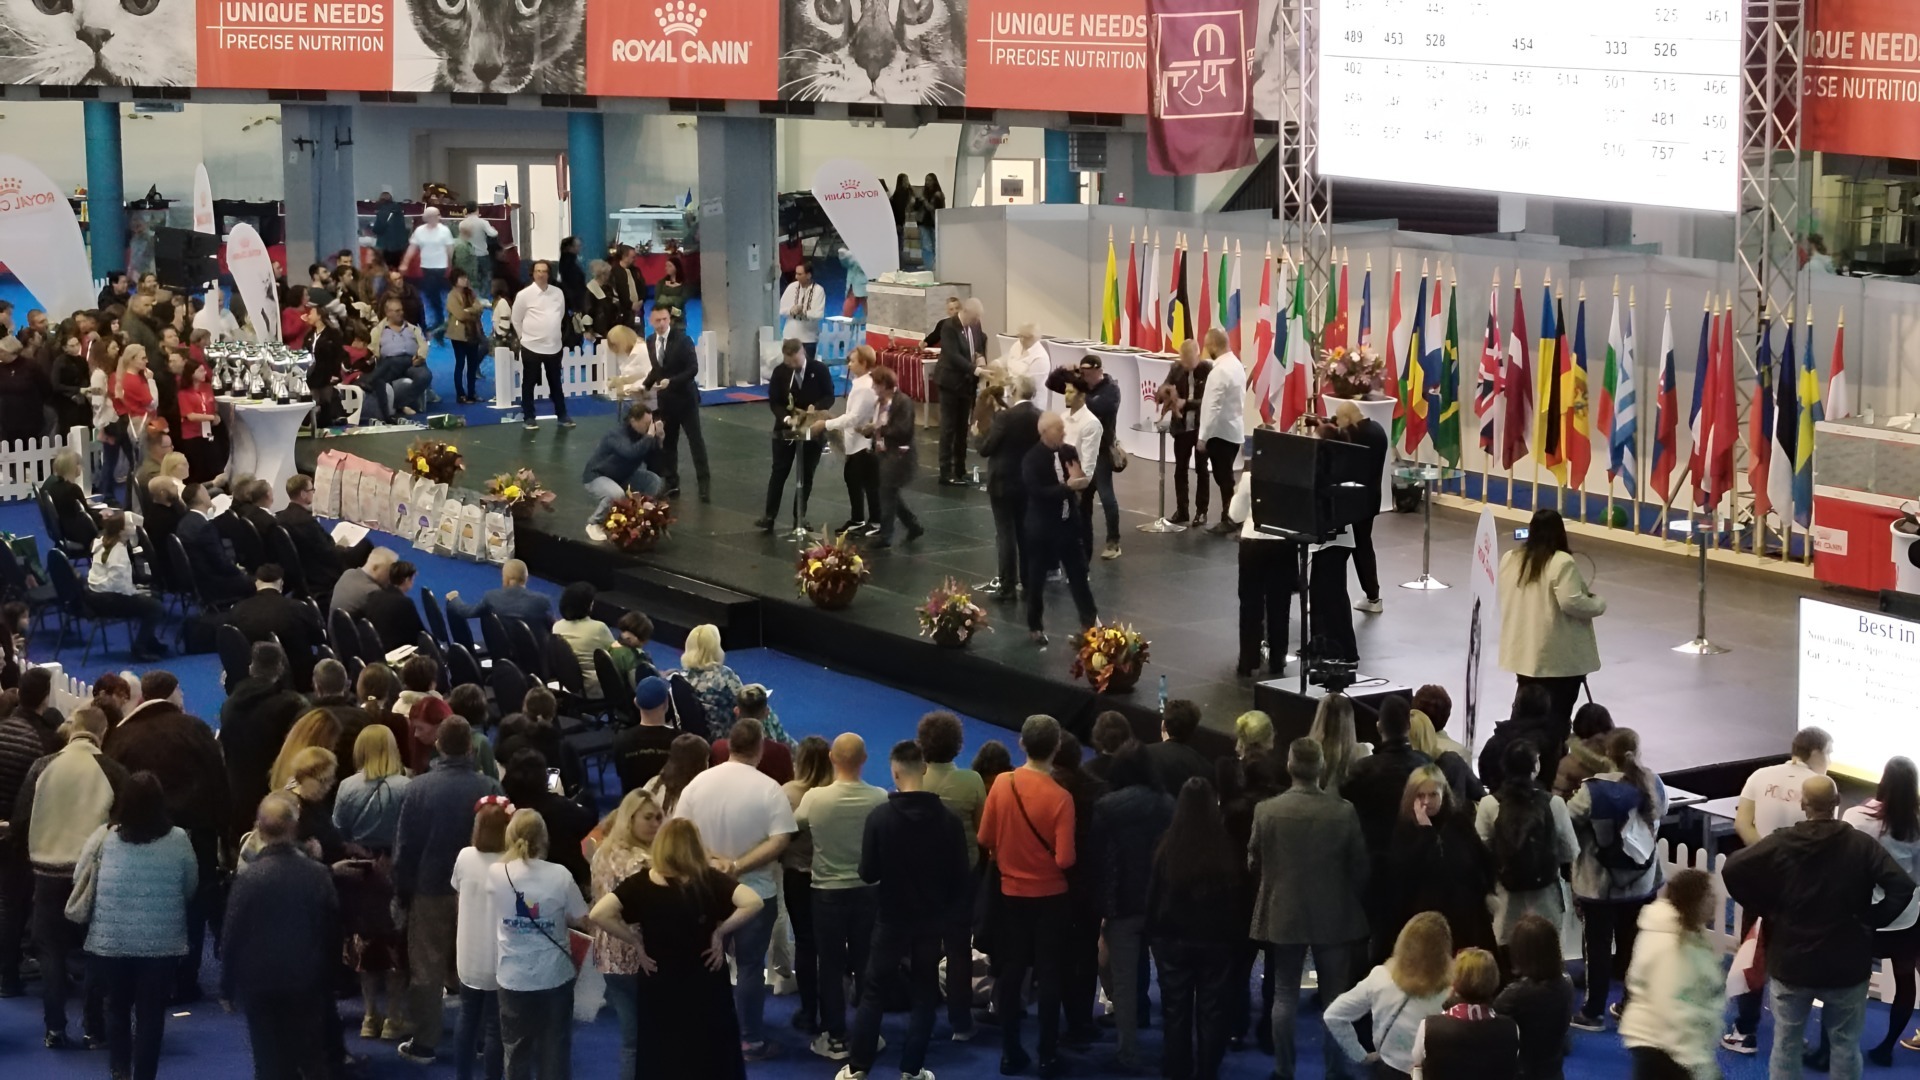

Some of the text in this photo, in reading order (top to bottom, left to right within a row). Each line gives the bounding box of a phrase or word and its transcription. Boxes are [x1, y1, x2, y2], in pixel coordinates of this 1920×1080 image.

[226, 2, 384, 24] UNIQUE NEEDS
[997, 12, 1147, 37] UNIQUE NEEDS
[1655, 8, 1678, 22] 525
[1706, 10, 1728, 23] 461
[227, 34, 384, 52] PRECISE NUTRITION
[612, 39, 749, 64] ROYAL CANIN
[1344, 30, 1678, 57] 489 453 528 454 333 526
[1860, 32, 1920, 62] NEED
[996, 48, 1147, 69] PRECISE NUTRITION
[1344, 62, 1362, 74] 402
[1604, 75, 1625, 89] 501
[1842, 77, 1920, 102] NUTRITIO
[1652, 112, 1675, 126] 481
[1703, 115, 1727, 129] 450
[1652, 146, 1675, 160] 757
[1859, 615, 1915, 644] Best in
